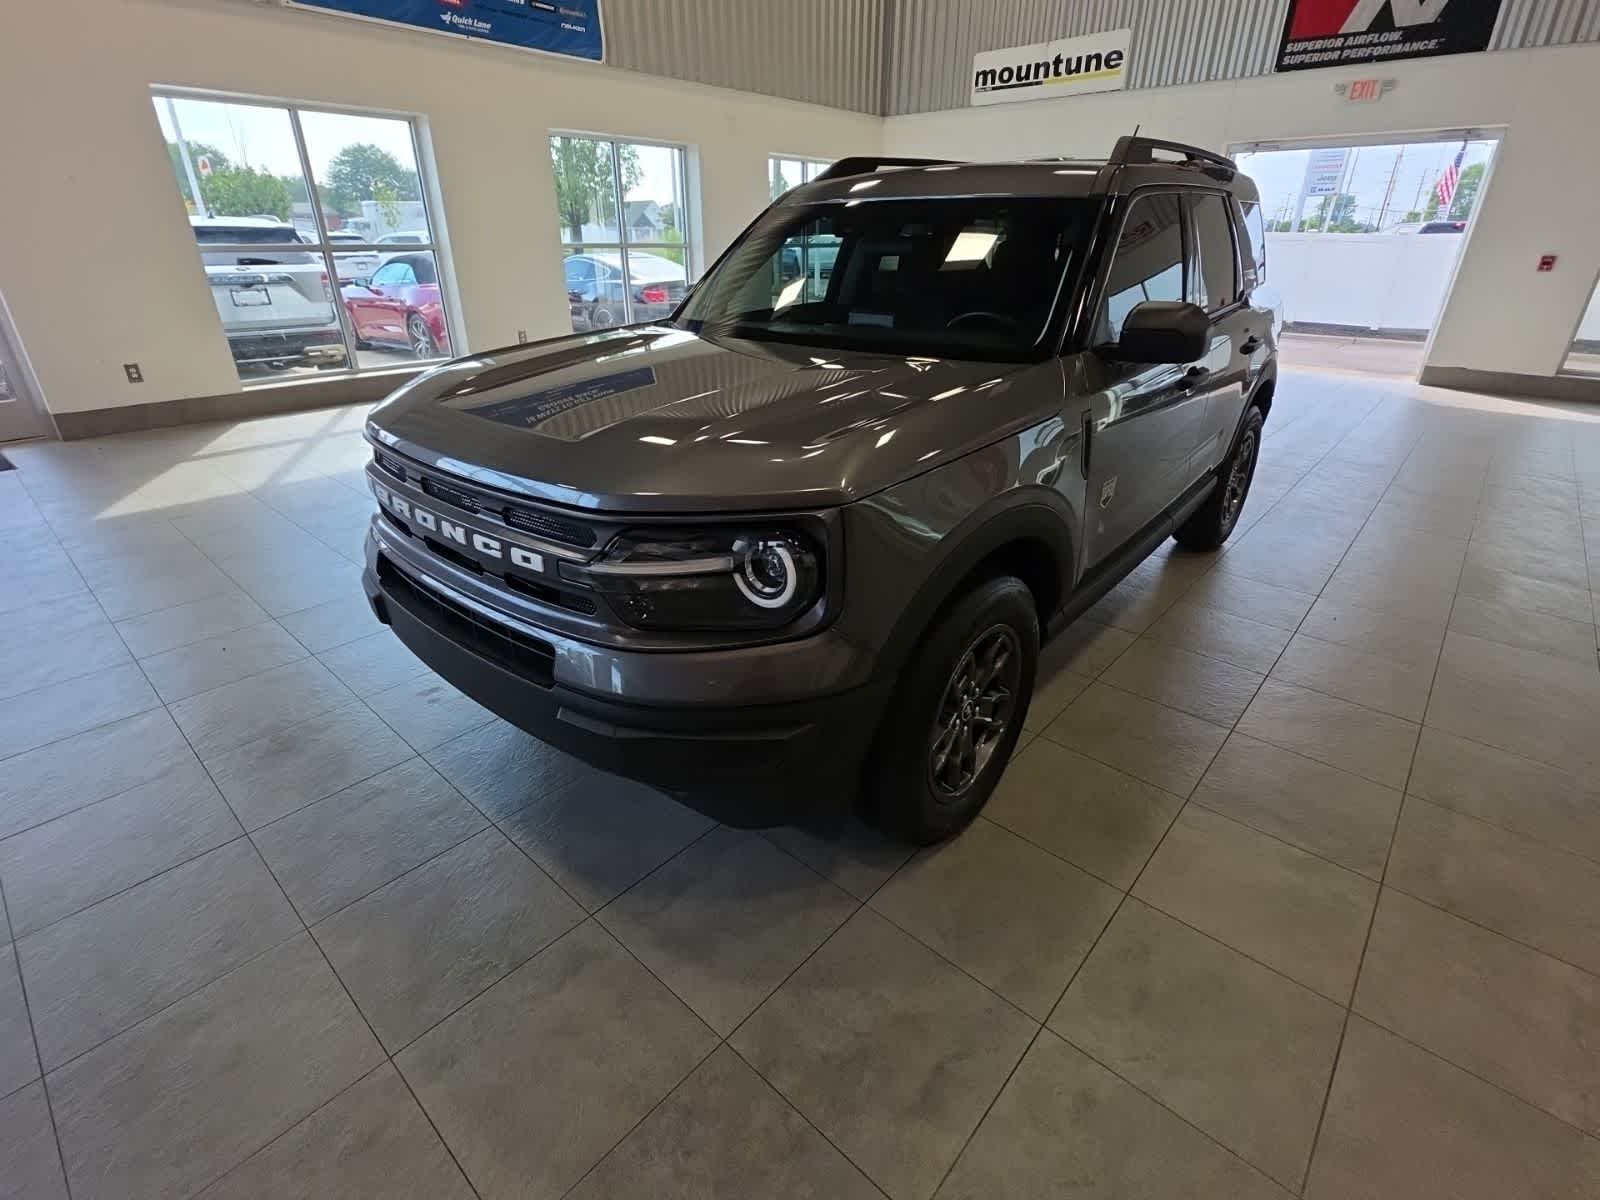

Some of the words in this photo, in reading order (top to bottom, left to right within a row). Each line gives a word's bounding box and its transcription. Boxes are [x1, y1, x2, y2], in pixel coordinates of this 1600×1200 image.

[452, 14, 474, 26] Quick
[474, 19, 492, 30] Lane
[1285, 37, 1344, 53] SUPERIOR
[1282, 50, 1342, 65] SUPERIOR
[974, 49, 1124, 88] mountune
[1349, 80, 1377, 100] EXIT
[373, 484, 544, 573] BRONCO
